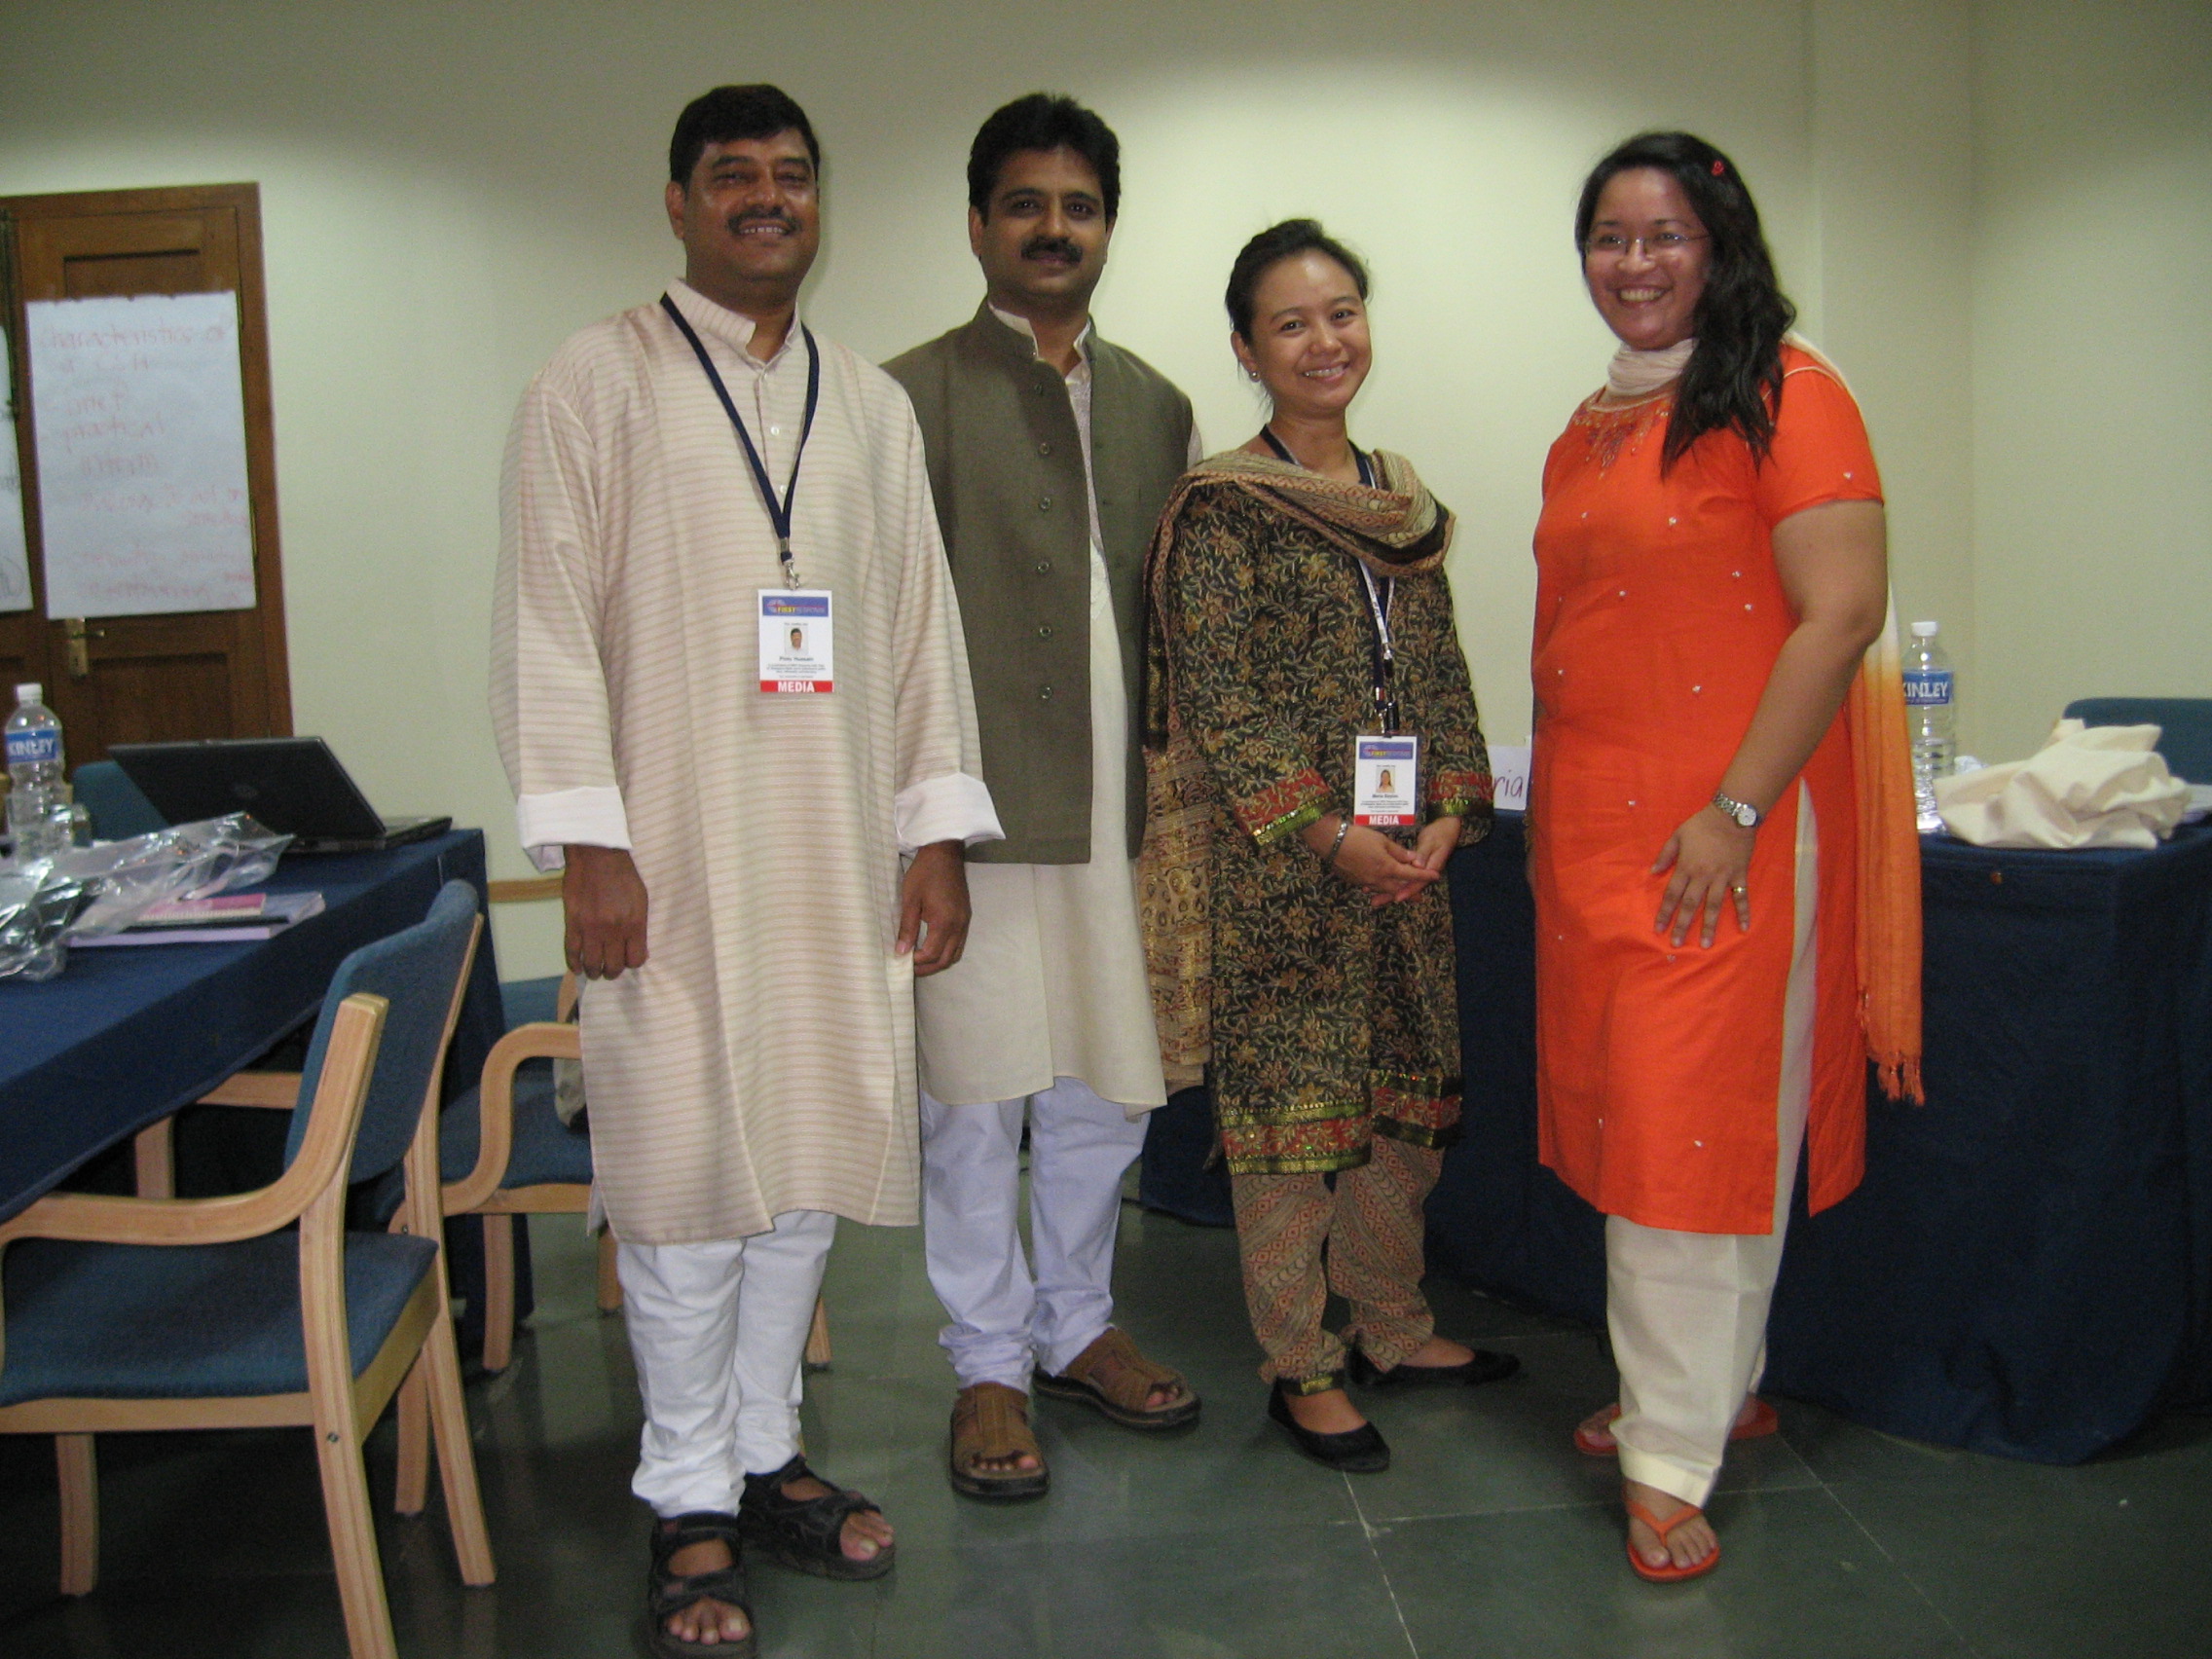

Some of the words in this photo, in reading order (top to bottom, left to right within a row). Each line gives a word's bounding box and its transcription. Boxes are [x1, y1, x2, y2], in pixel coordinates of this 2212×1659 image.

[777, 682, 815, 692] MEDIA
[8, 738, 54, 756] KINLEY
[1493, 769, 1524, 798] ria
[1369, 816, 1399, 826] MEDIA
